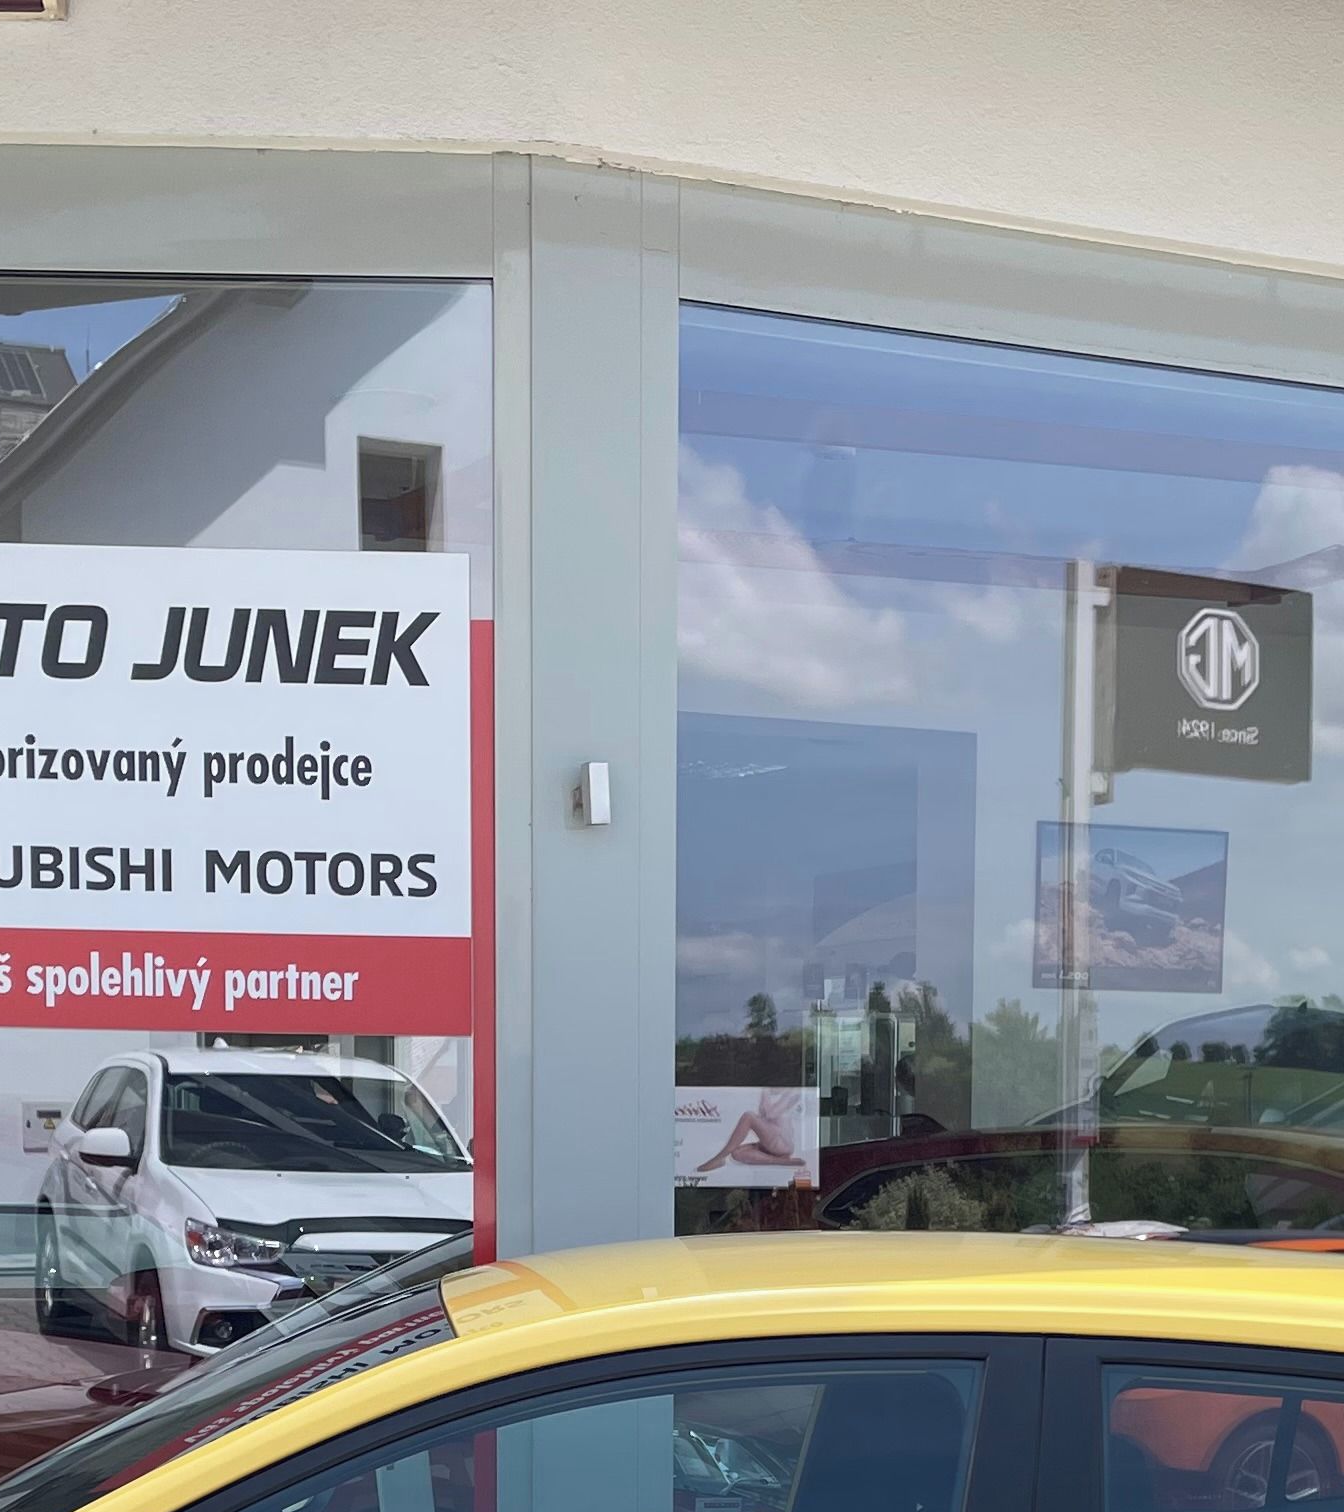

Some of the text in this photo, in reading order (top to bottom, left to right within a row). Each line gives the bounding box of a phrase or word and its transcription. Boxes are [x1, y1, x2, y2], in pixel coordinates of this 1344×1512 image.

[131, 606, 441, 687] JUNEK
[203, 735, 374, 801] prodejce
[205, 849, 438, 898] MOTORS
[26, 952, 212, 1011] spolehlivý
[224, 963, 360, 1009] partner
